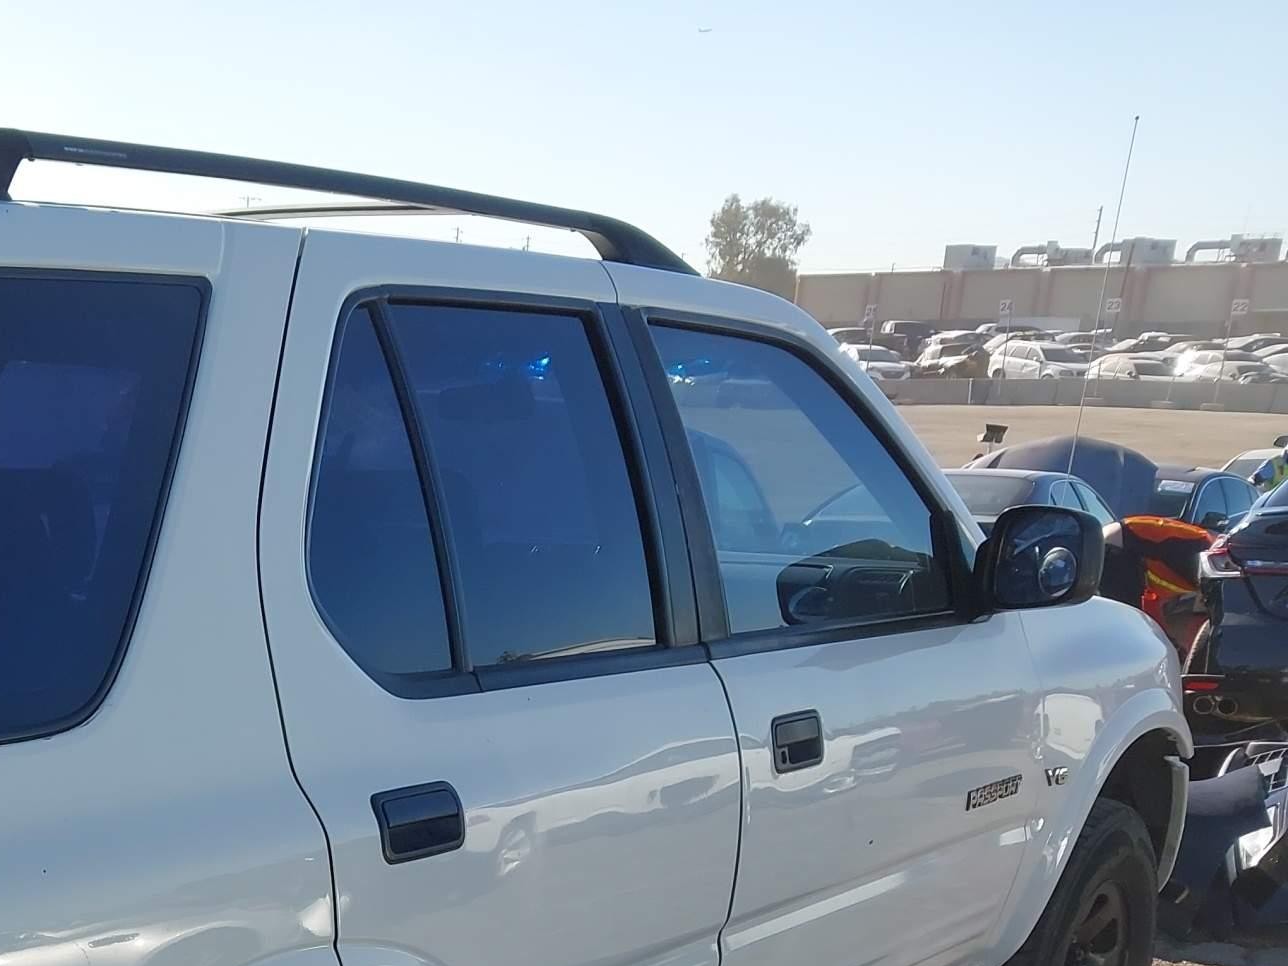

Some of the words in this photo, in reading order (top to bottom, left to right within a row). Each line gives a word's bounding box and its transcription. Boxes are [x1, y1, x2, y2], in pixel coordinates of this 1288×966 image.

[1106, 300, 1121, 311] 23
[1232, 302, 1248, 312] 22
[1044, 766, 1069, 786] V6
